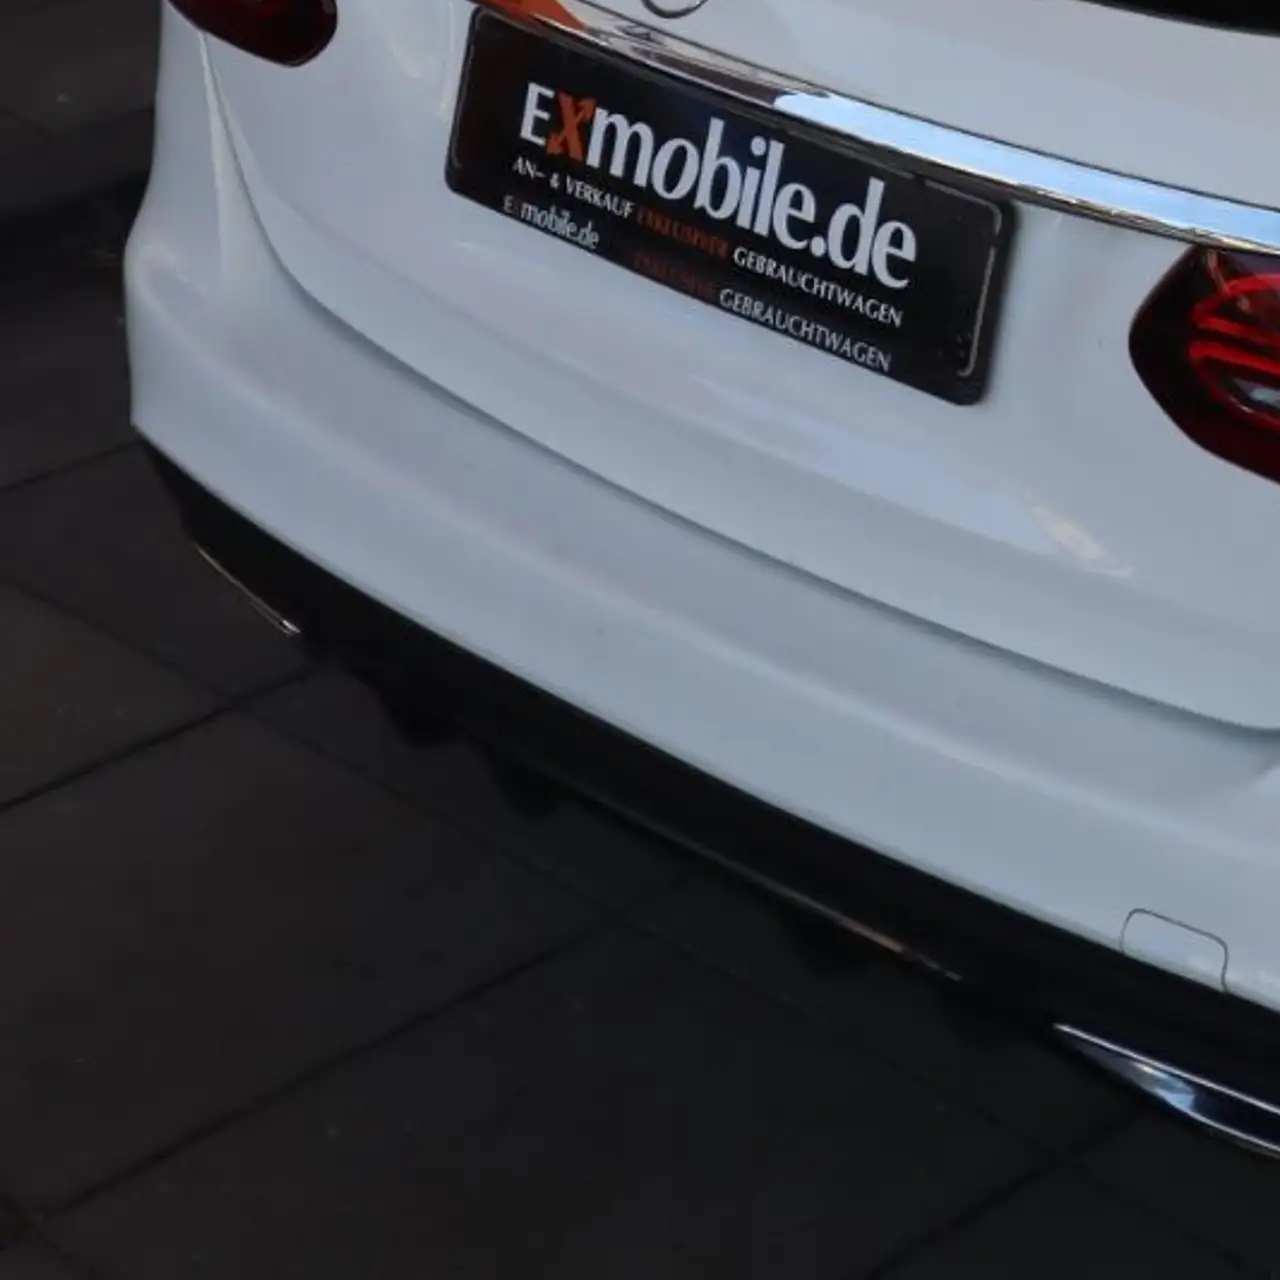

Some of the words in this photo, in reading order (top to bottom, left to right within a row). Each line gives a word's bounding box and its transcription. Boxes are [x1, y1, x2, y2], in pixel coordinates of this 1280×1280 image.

[565, 174, 635, 219] VERKAUF
[734, 248, 903, 328] GEBRAUCHTWAGEN
[720, 289, 891, 372] GEBRAUCHTWAGEN
